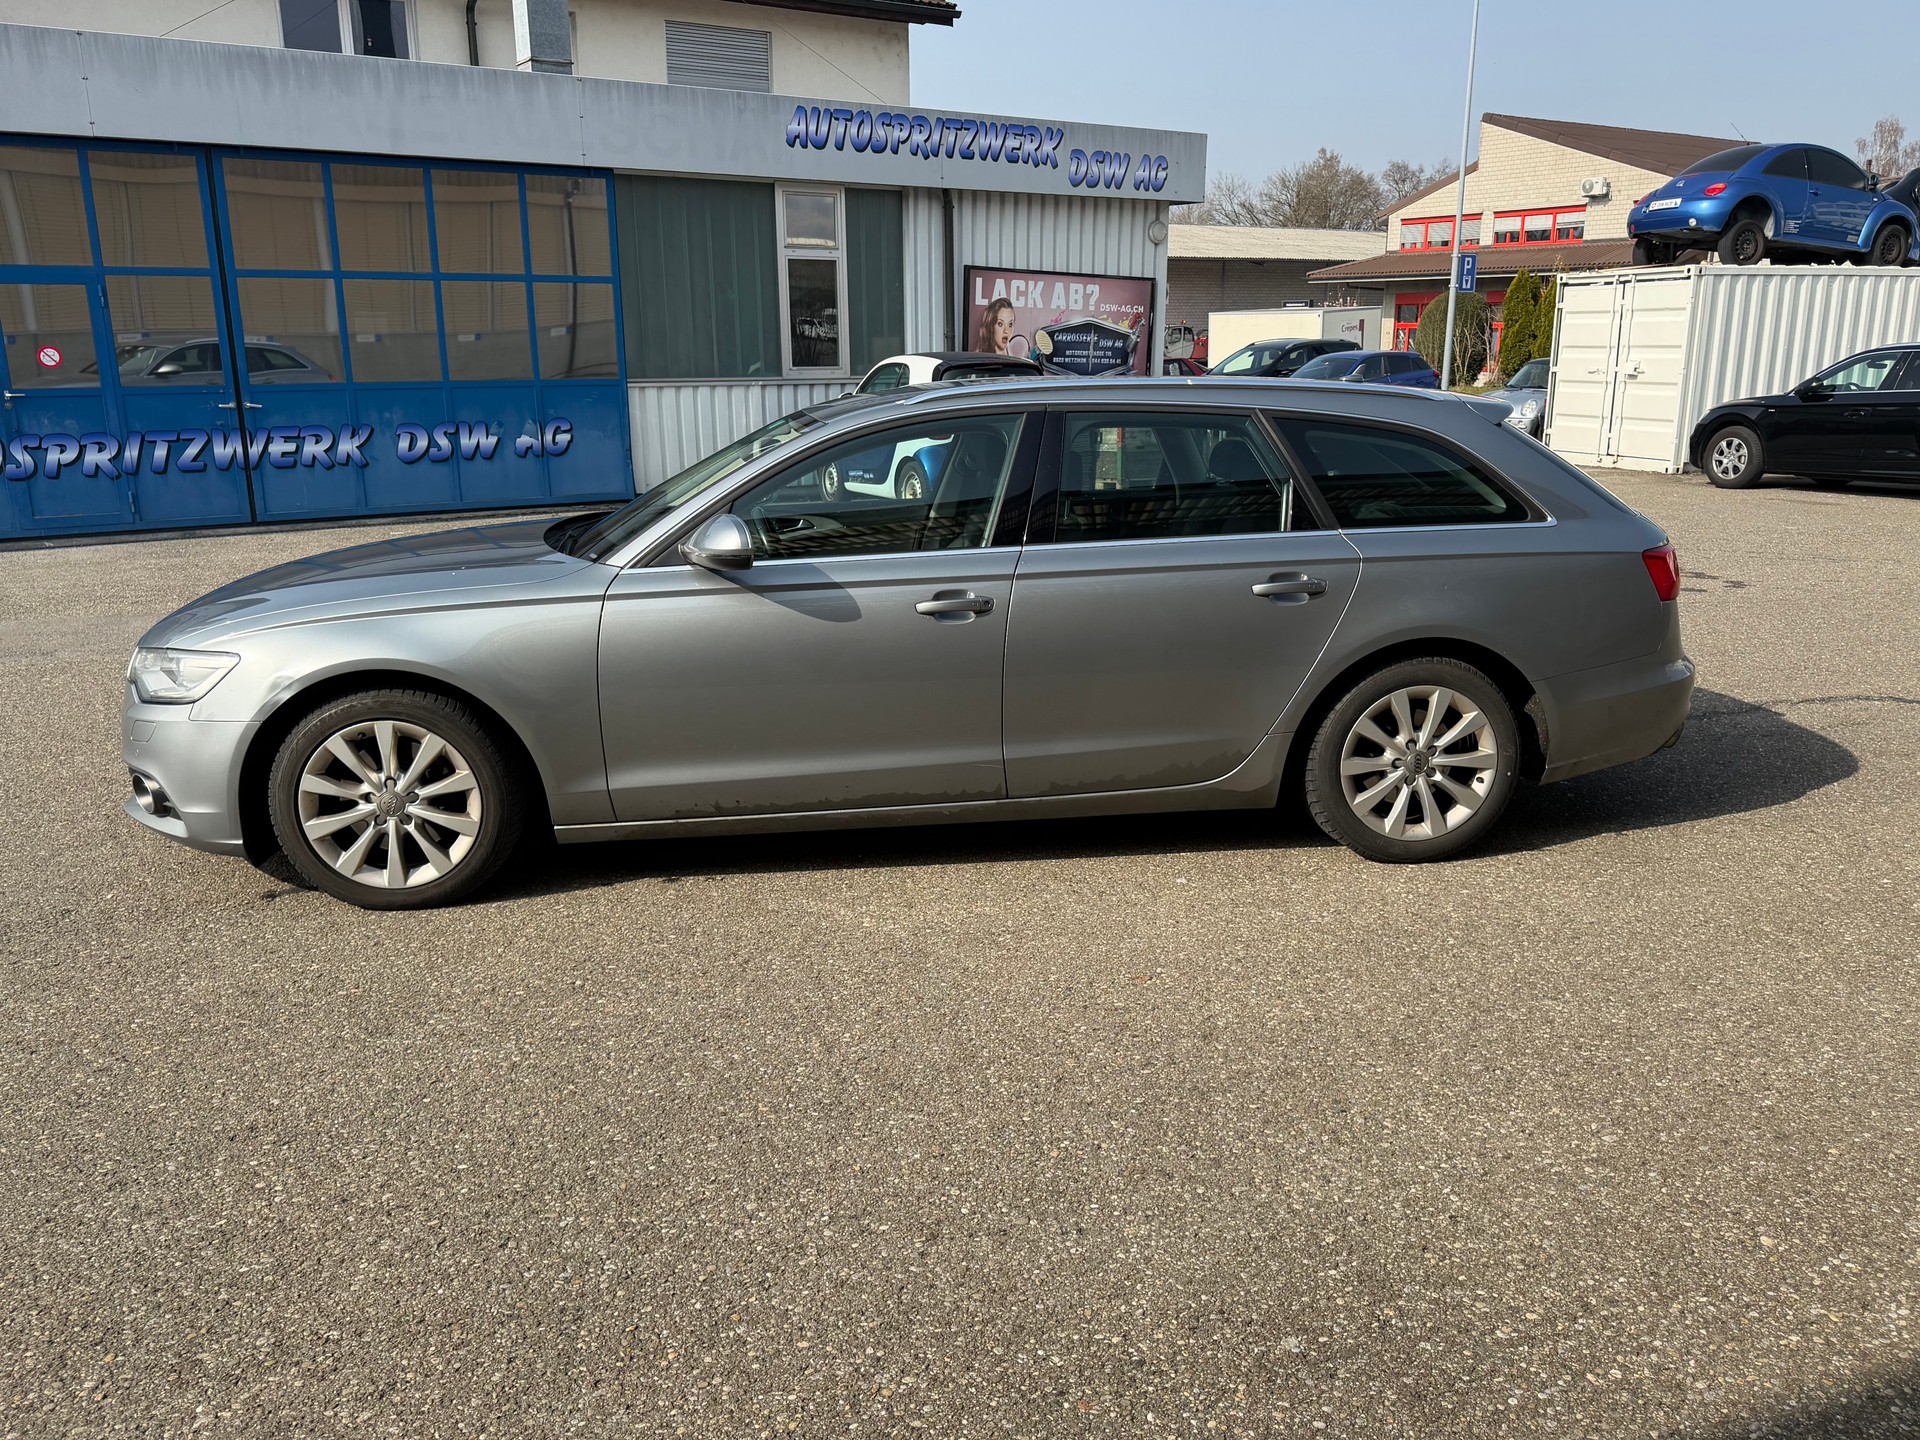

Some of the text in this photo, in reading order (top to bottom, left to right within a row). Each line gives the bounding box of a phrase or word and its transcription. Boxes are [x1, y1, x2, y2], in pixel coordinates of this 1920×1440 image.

[786, 105, 1064, 169] AUTOSPRITZWERK
[1068, 148, 1131, 190] DSW
[1133, 153, 1169, 193] AG
[1463, 257, 1473, 275] P
[975, 277, 1100, 311] LACK AB?
[1100, 303, 1144, 313] DSW-AG.CH
[1054, 332, 1124, 349] CARROSSERE DSW AG
[0, 416, 574, 482] SPRITZWERK DSW AG
